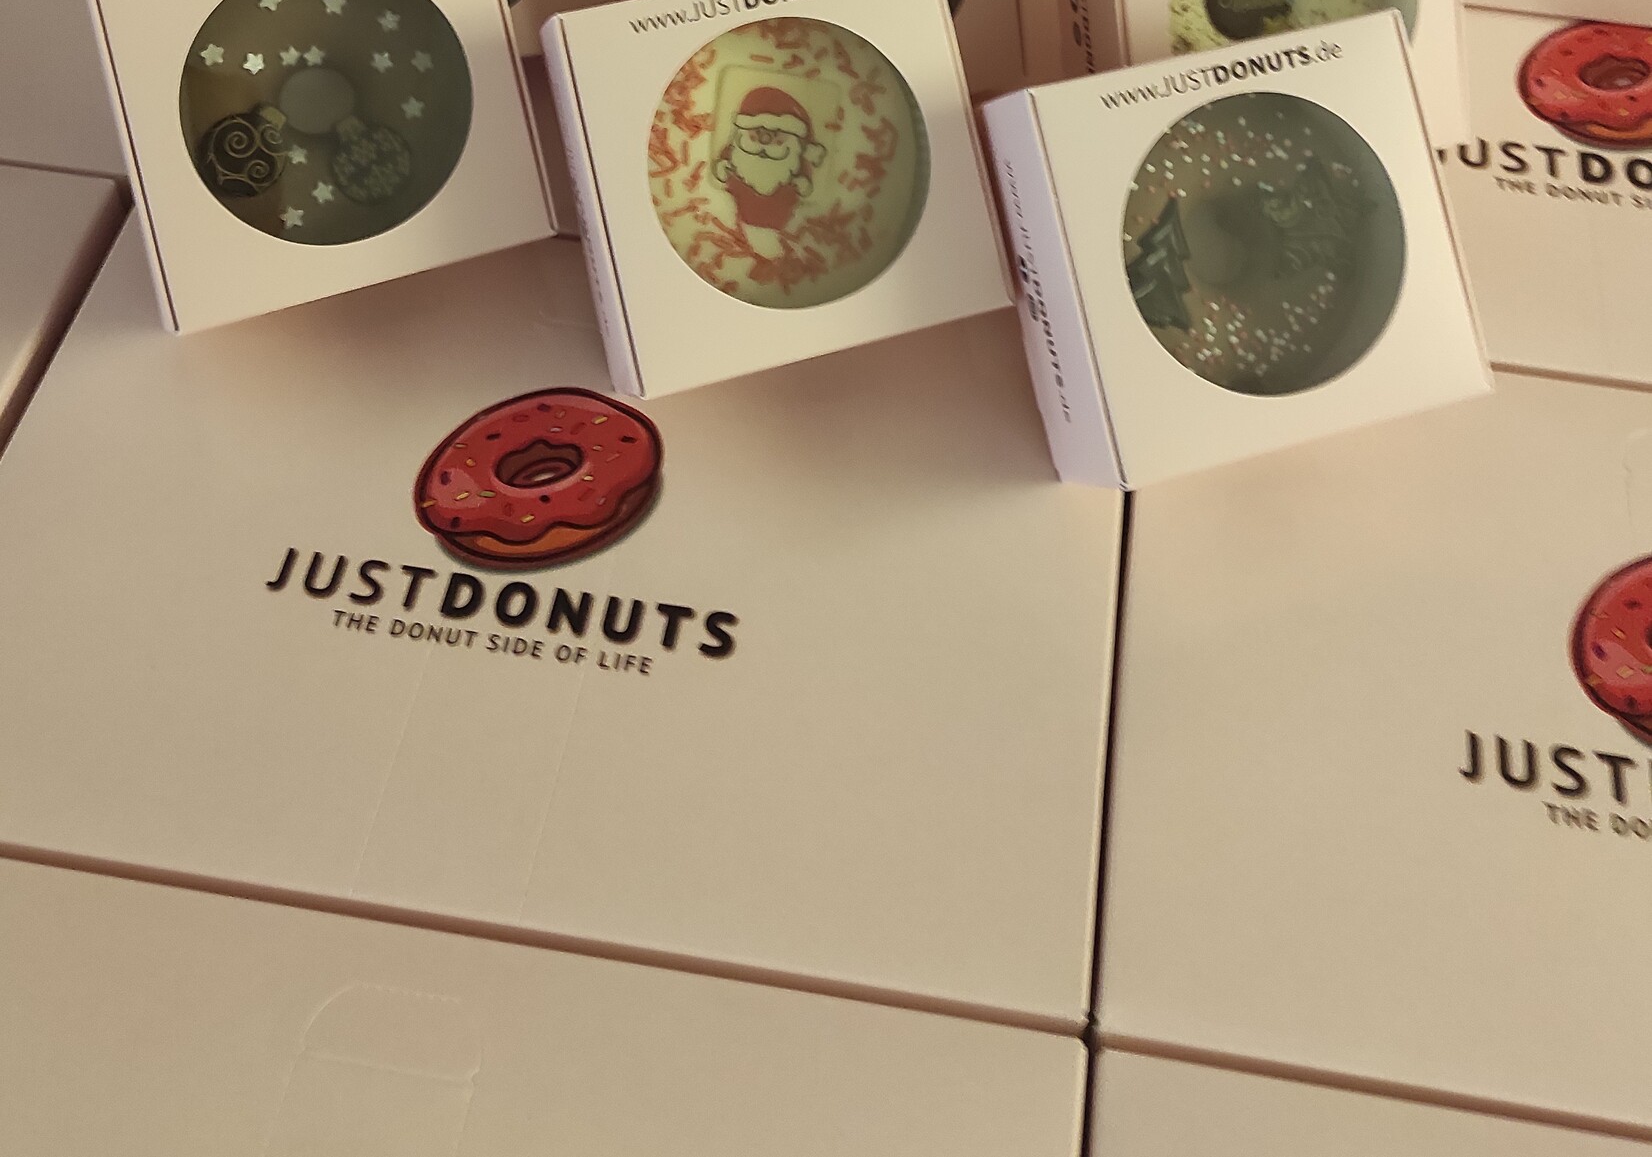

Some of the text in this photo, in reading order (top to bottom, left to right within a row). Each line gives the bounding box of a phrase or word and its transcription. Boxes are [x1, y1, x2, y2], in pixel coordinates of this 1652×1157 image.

[1099, 40, 1344, 110] www.JUSTDONUTS.de
[1495, 176, 1537, 195] THE
[1546, 183, 1623, 206] DONUT
[266, 547, 740, 659] JUSTDONUTS
[333, 609, 654, 676] THE DONUT SIDE OF LIFE
[1459, 729, 1652, 806] JUST
[1541, 800, 1652, 840] THE DO
